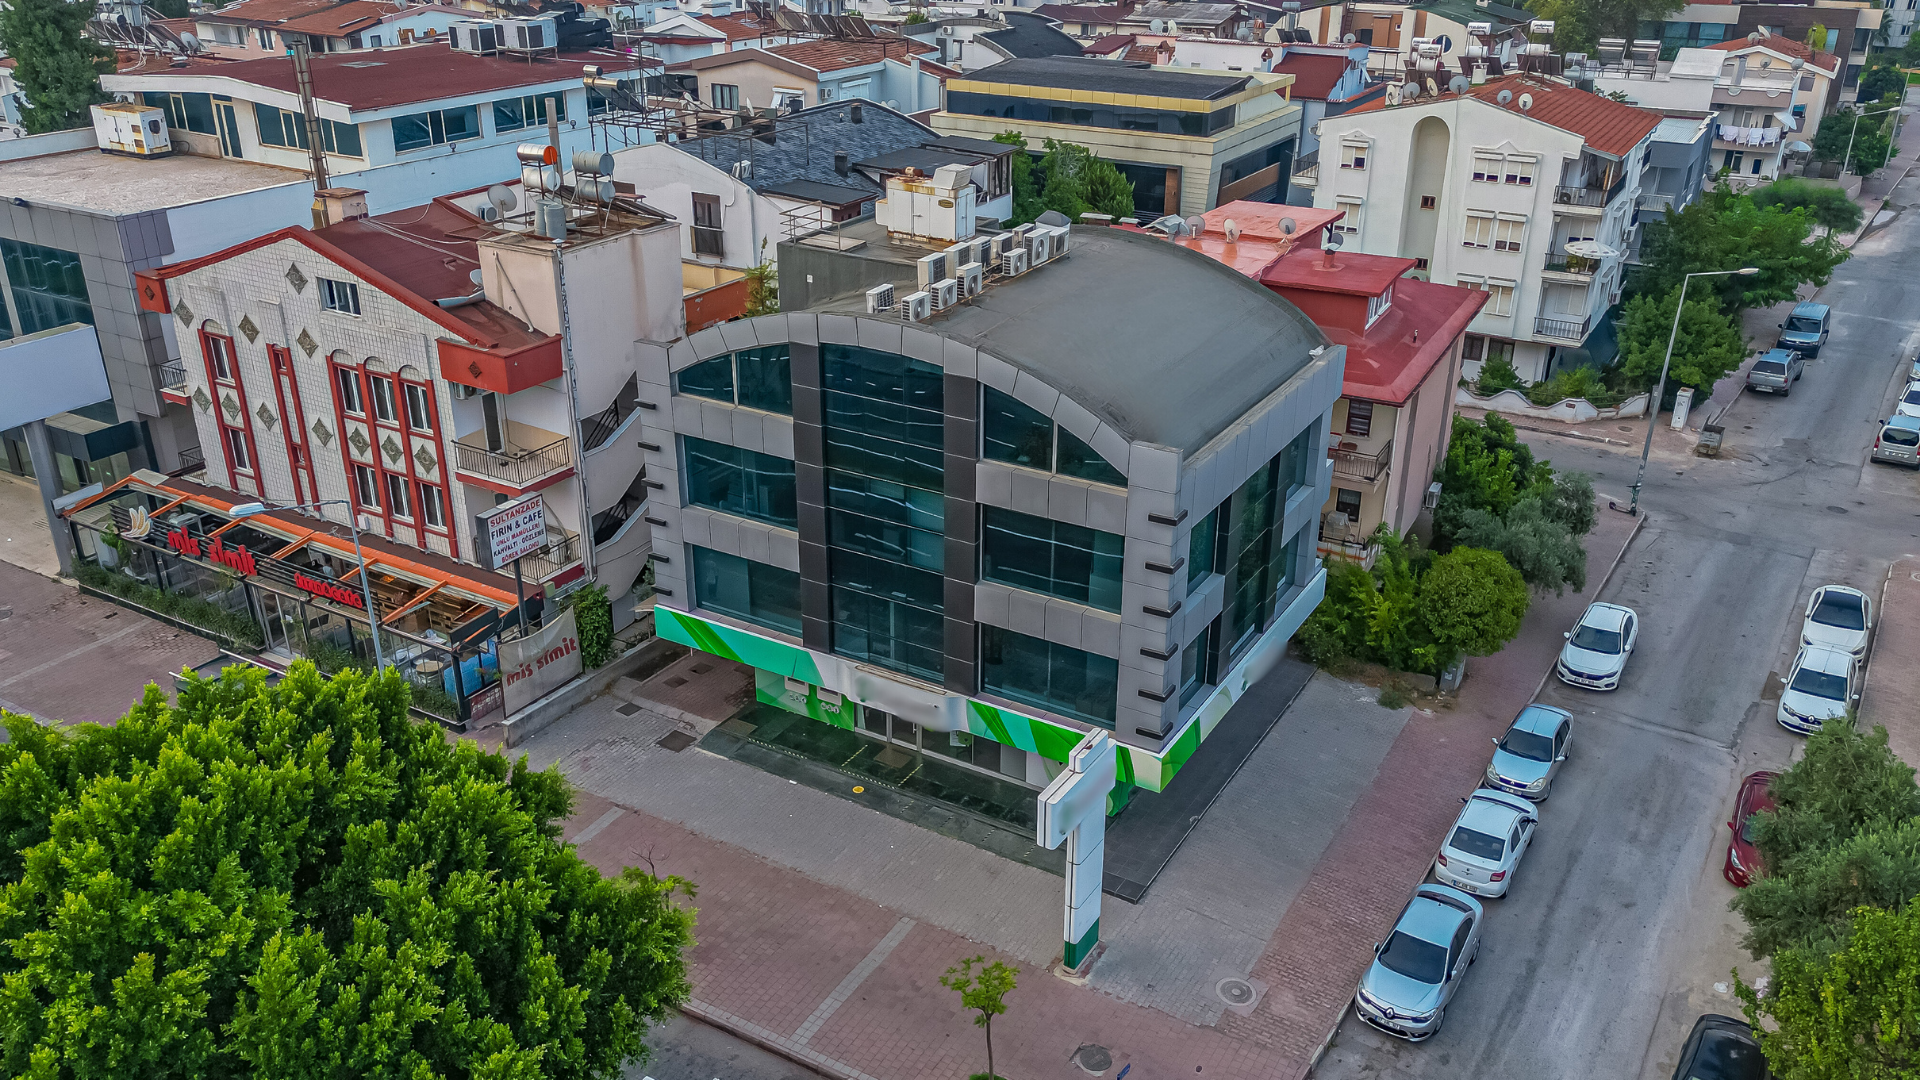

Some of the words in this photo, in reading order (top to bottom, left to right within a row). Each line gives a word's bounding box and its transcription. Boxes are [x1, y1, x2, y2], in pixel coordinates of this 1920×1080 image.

[490, 500, 540, 527] SULTANZADE
[491, 523, 512, 540] FIRIN
[514, 520, 521, 529] &
[522, 509, 543, 525] CAFE
[167, 525, 201, 556] mis
[208, 536, 258, 577] simit
[495, 536, 511, 547] UNLU
[506, 662, 534, 687] mis
[535, 637, 577, 670] simit
